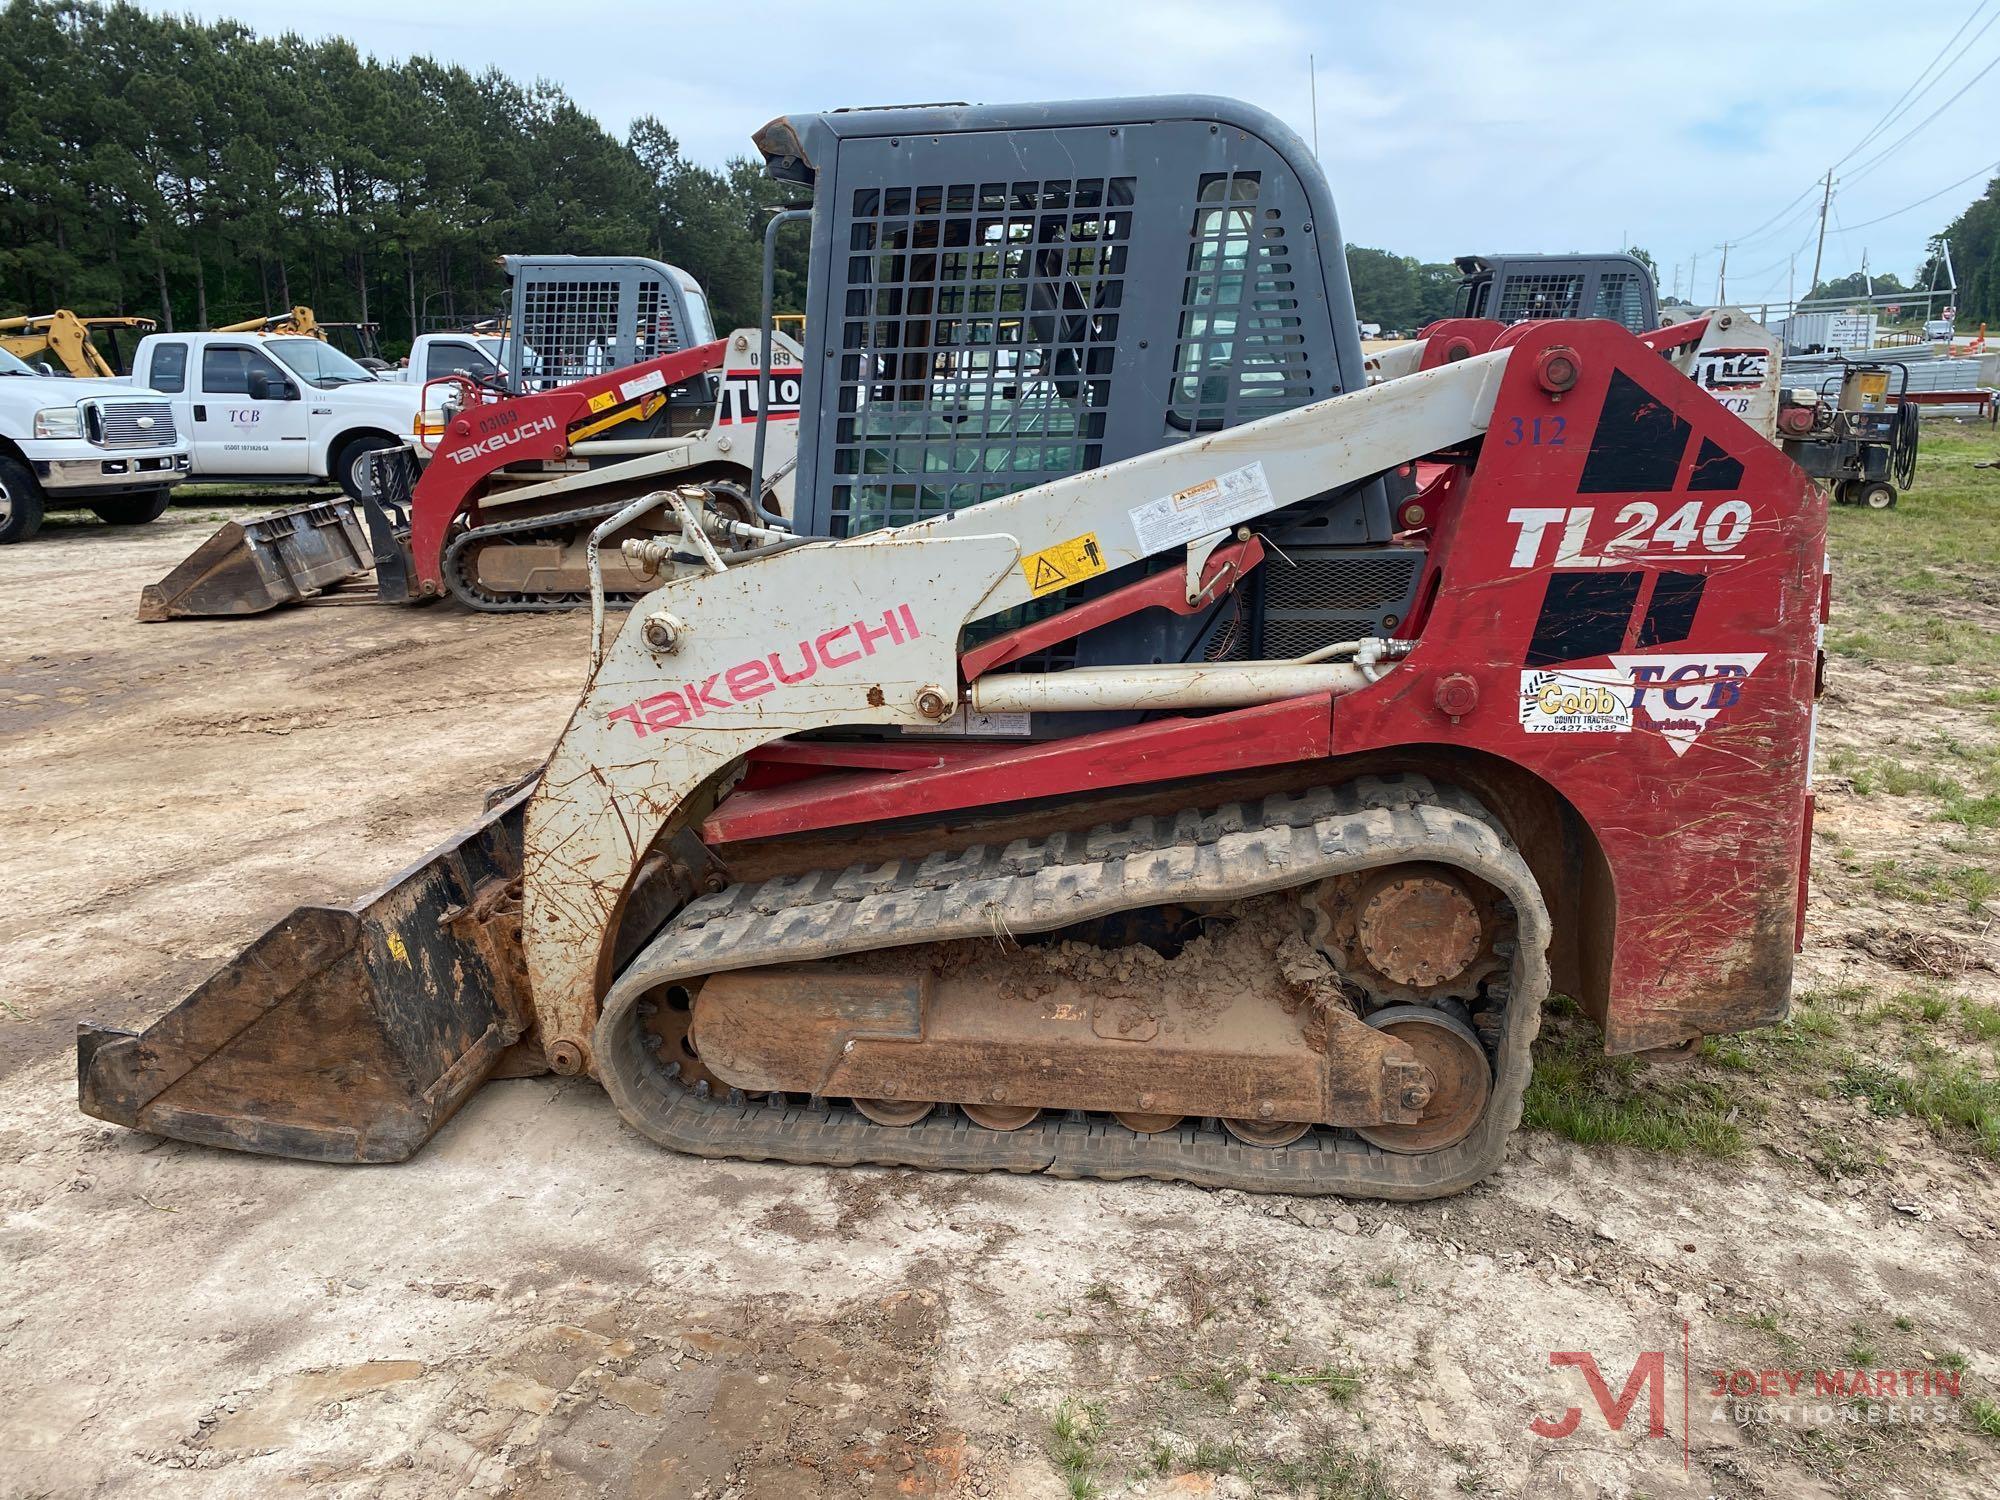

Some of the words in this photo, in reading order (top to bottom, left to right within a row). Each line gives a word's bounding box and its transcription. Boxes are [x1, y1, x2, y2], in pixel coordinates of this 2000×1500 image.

[228, 409, 260, 422] TCB
[1504, 416, 1567, 446] 312
[446, 415, 557, 464] TAKEUCHI
[1507, 500, 1752, 568] TL240
[608, 603, 921, 738] TAKEUCHI
[1627, 664, 1749, 710] TCB
[1538, 682, 1615, 715] Cobb
[1554, 715, 1581, 724] COUNTY
